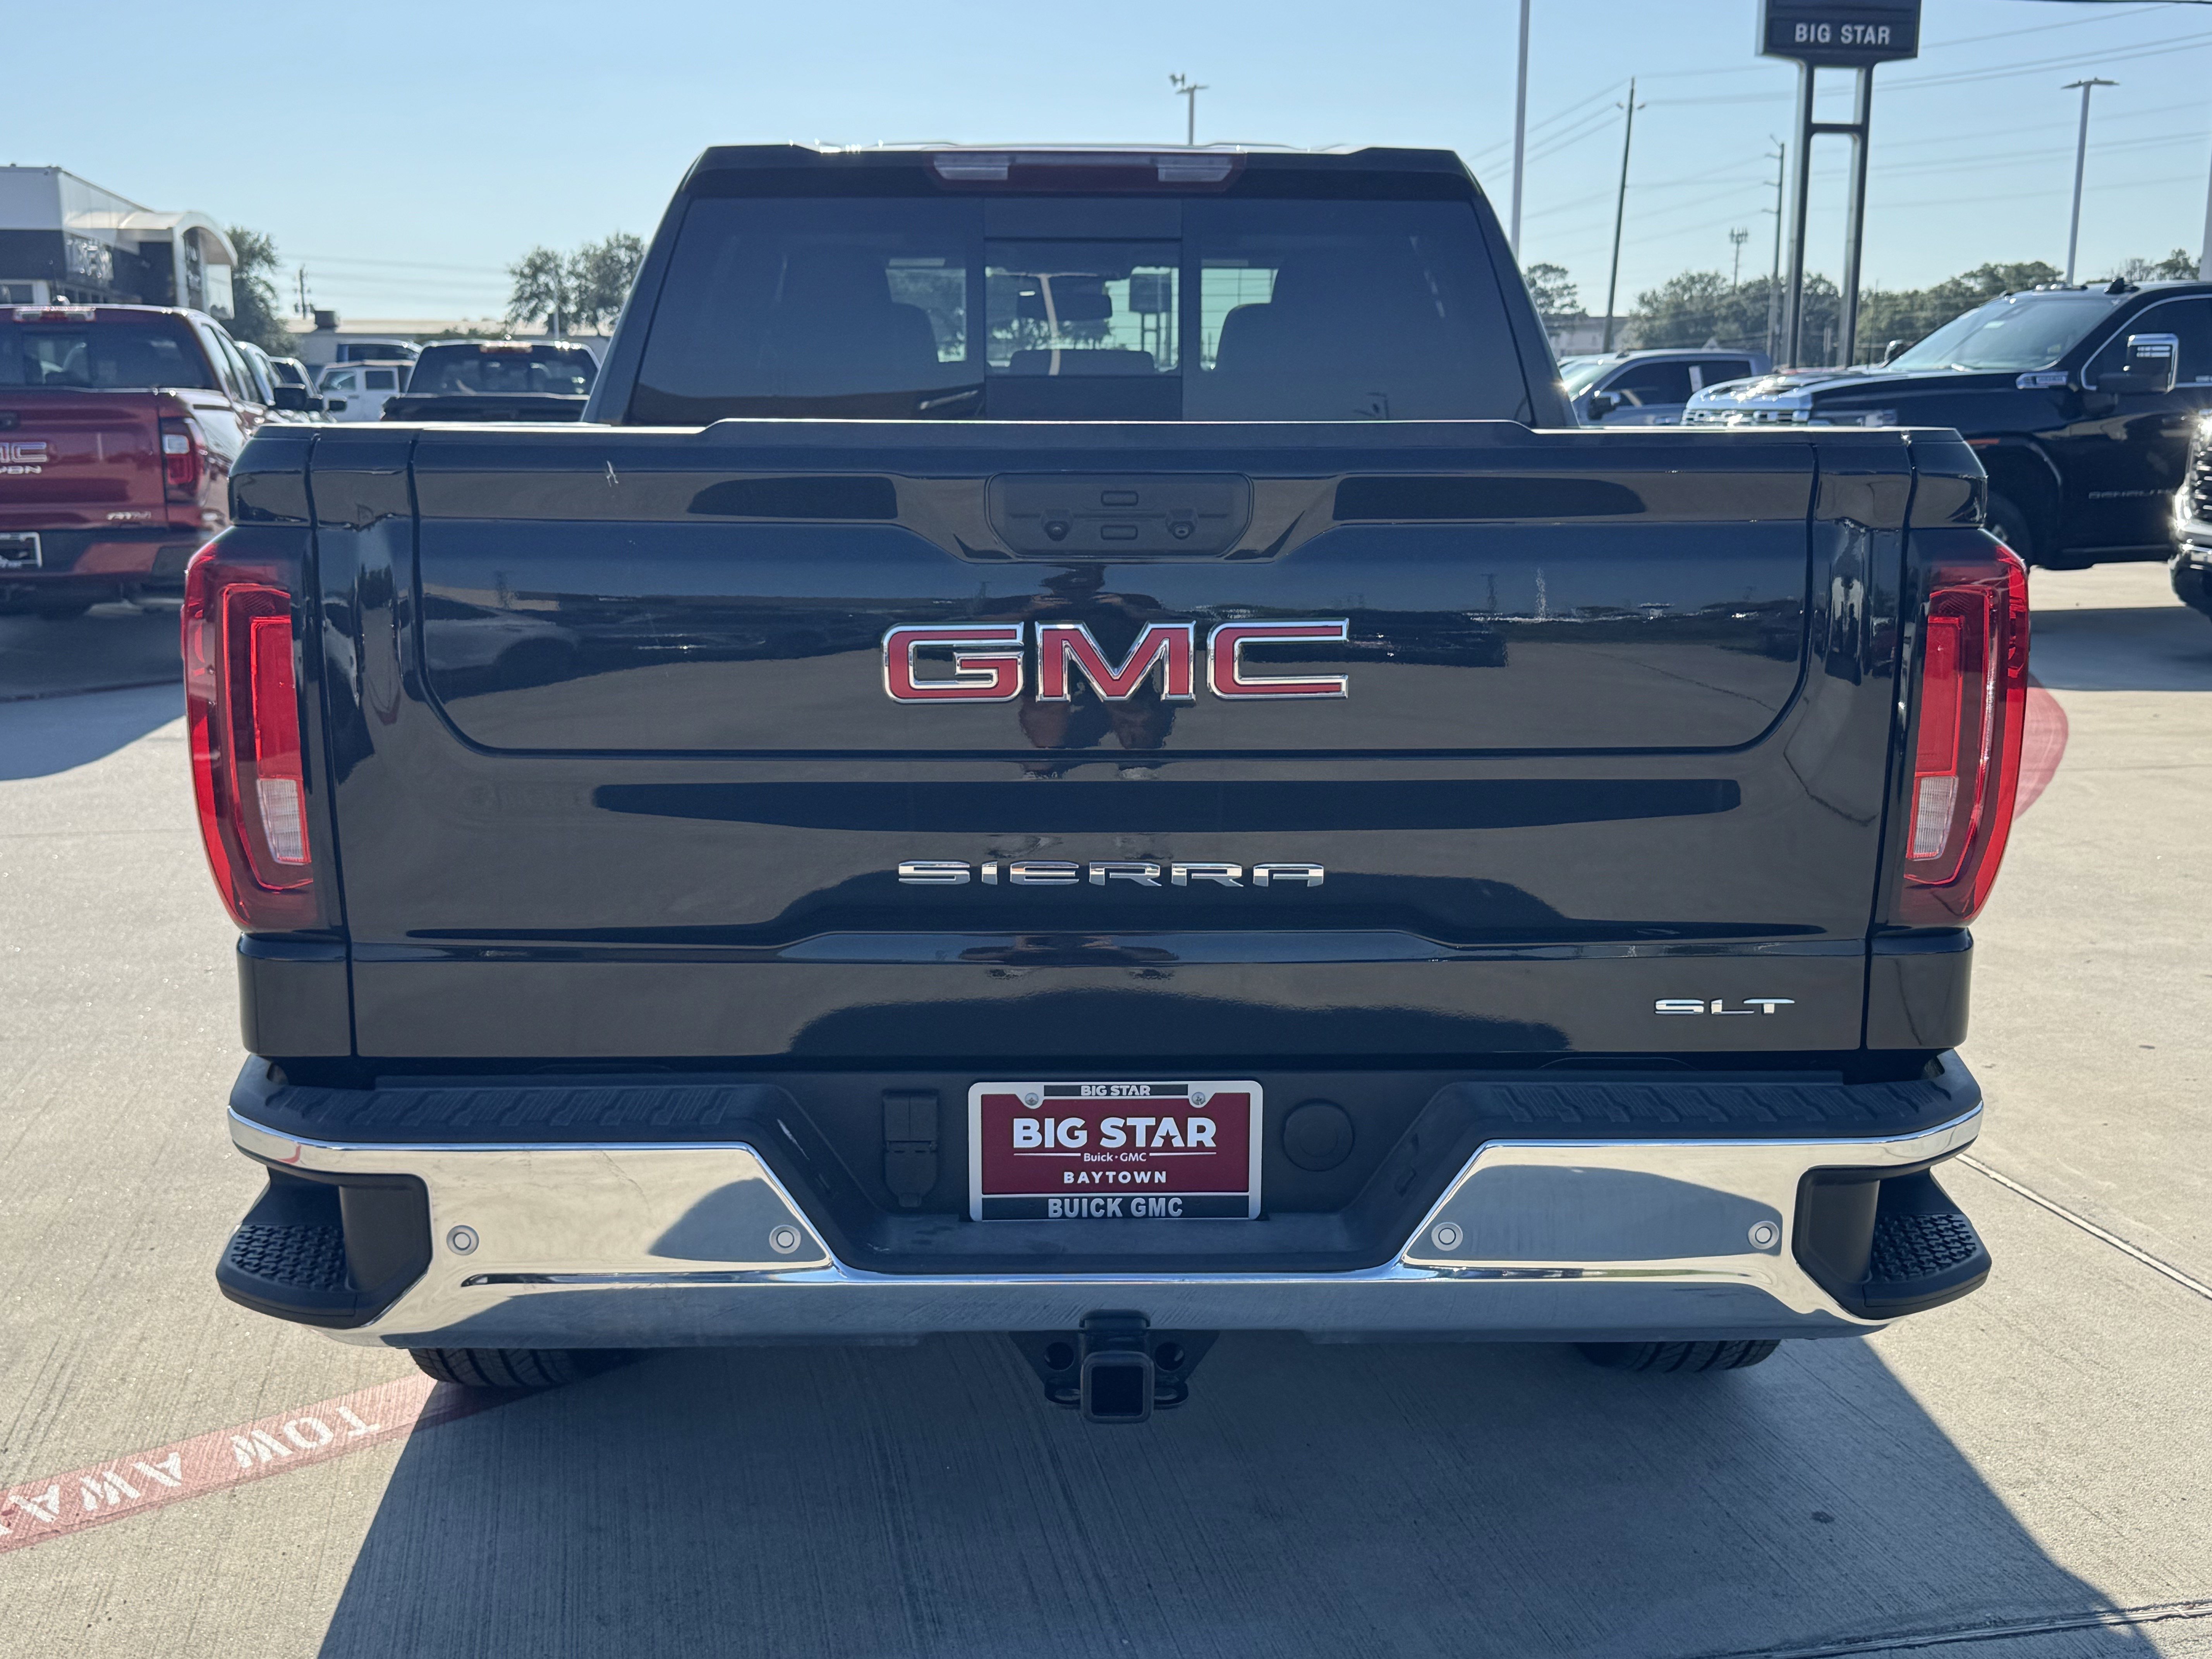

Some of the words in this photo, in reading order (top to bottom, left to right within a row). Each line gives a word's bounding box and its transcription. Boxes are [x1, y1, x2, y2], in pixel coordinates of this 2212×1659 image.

[1795, 23, 1831, 43] BIG
[1840, 24, 1890, 45] STAR
[881, 618, 1349, 702] GMC
[898, 860, 1324, 887] SIERRA
[1655, 999, 1795, 1014] SLT
[1081, 1085, 1107, 1096] BIG
[1110, 1085, 1150, 1096] STAR
[1013, 1117, 1087, 1148] BIG
[1100, 1117, 1216, 1148] STAR
[1064, 1171, 1166, 1183] BAYTOWN
[1048, 1198, 1123, 1218] BUICK
[1130, 1197, 1183, 1217] GMC
[231, 1406, 381, 1468] TOW
[0, 1452, 182, 1536] AWA
